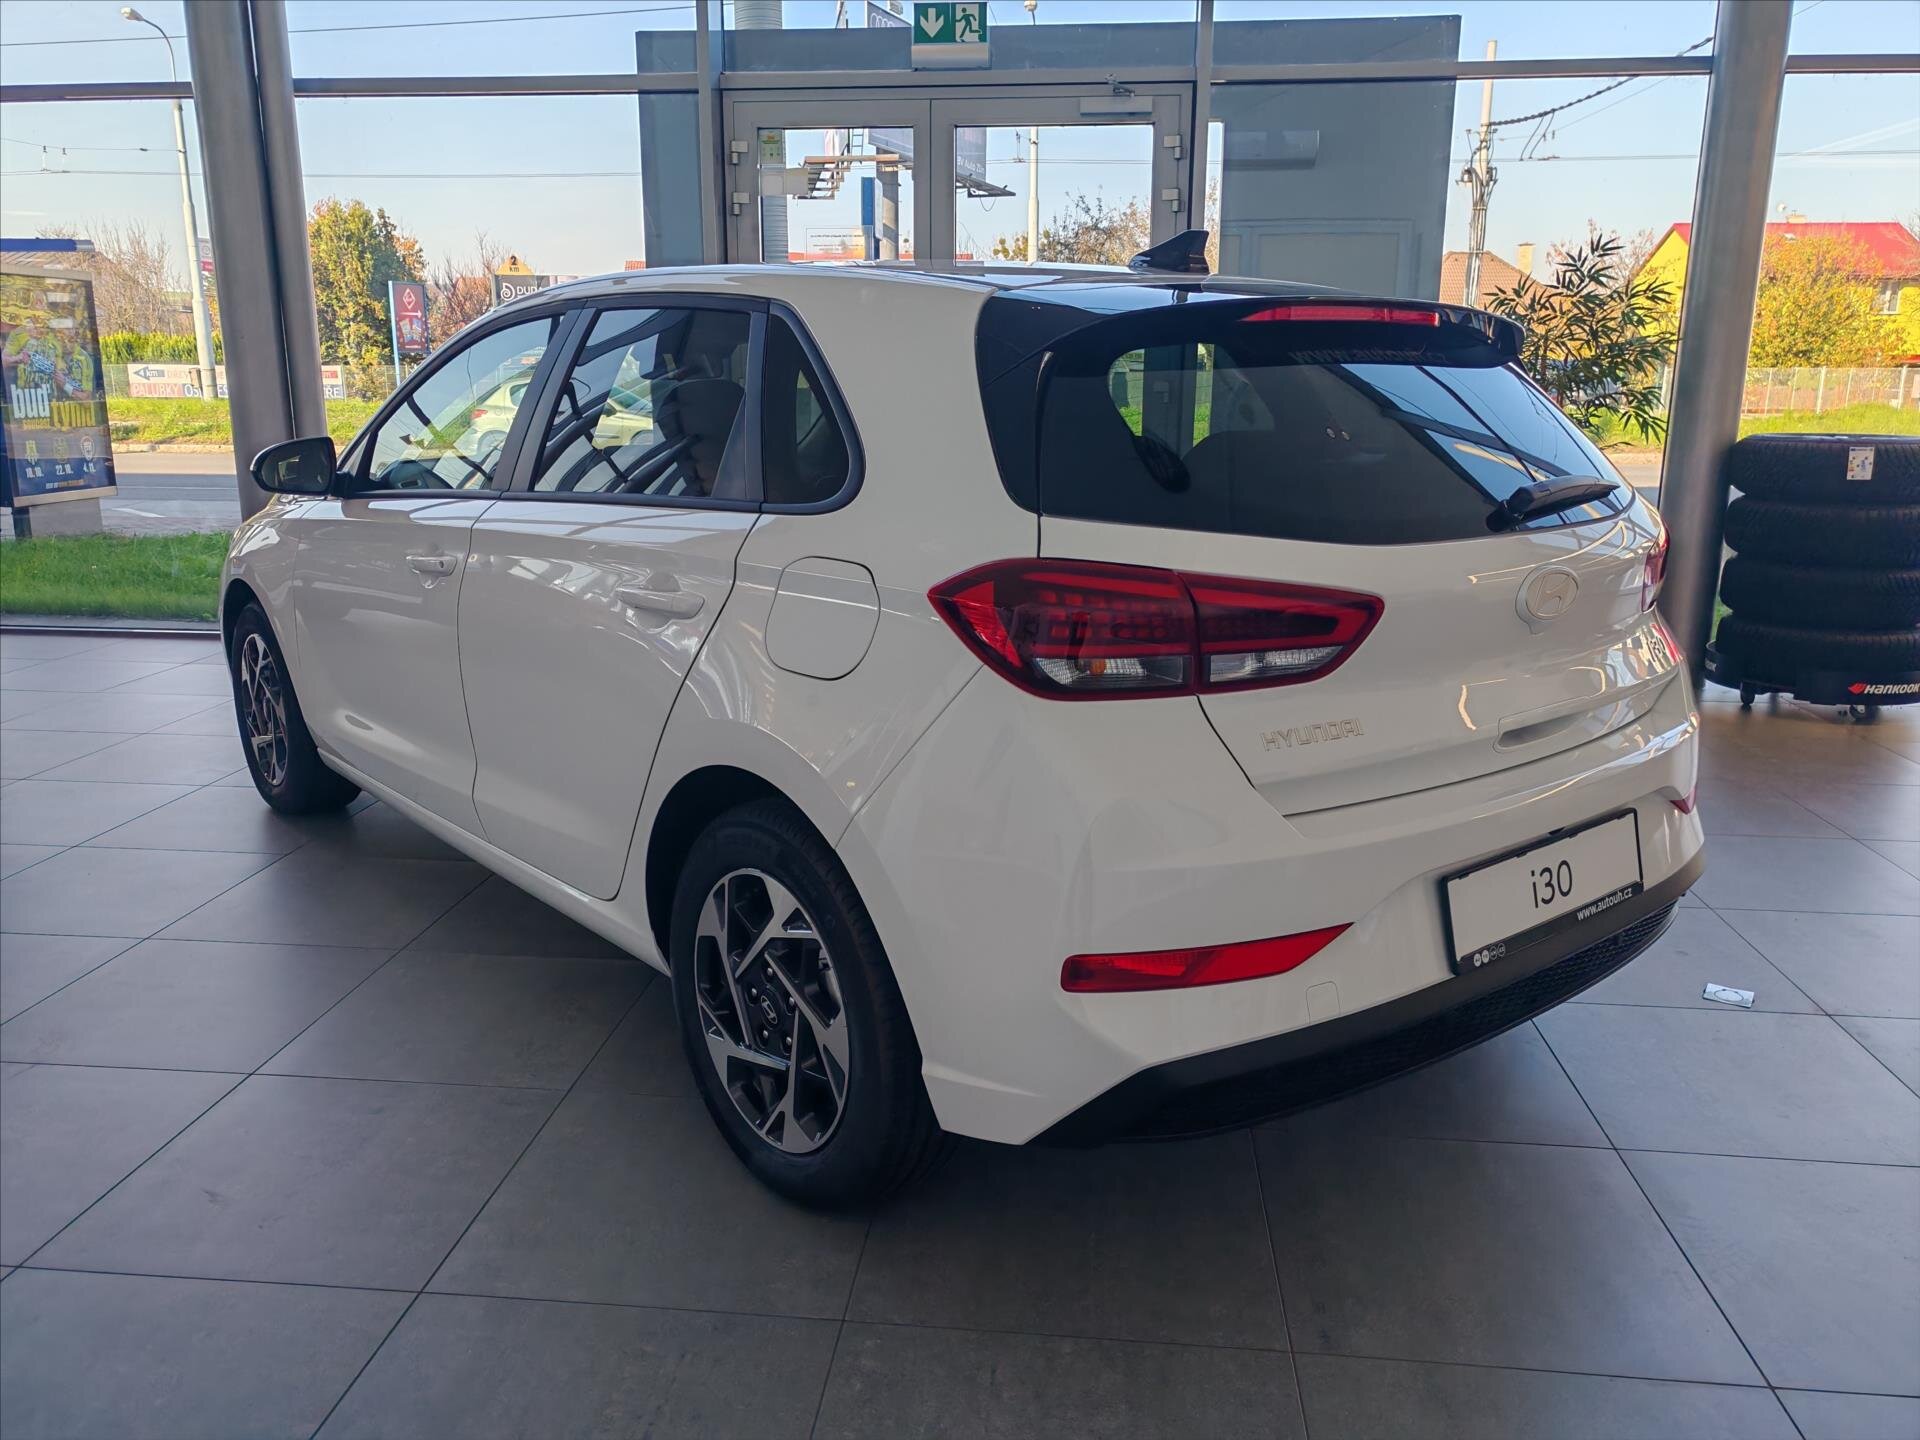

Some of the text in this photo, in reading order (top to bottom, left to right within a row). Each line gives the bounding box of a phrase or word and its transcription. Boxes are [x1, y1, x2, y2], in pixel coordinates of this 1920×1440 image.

[510, 255, 518, 266] 2
[146, 369, 159, 377] km
[131, 384, 180, 396] PALUBKY
[1259, 717, 1366, 752] HYUNDAI
[1530, 859, 1573, 910] i30
[1576, 886, 1634, 922] www.autouh.cz
